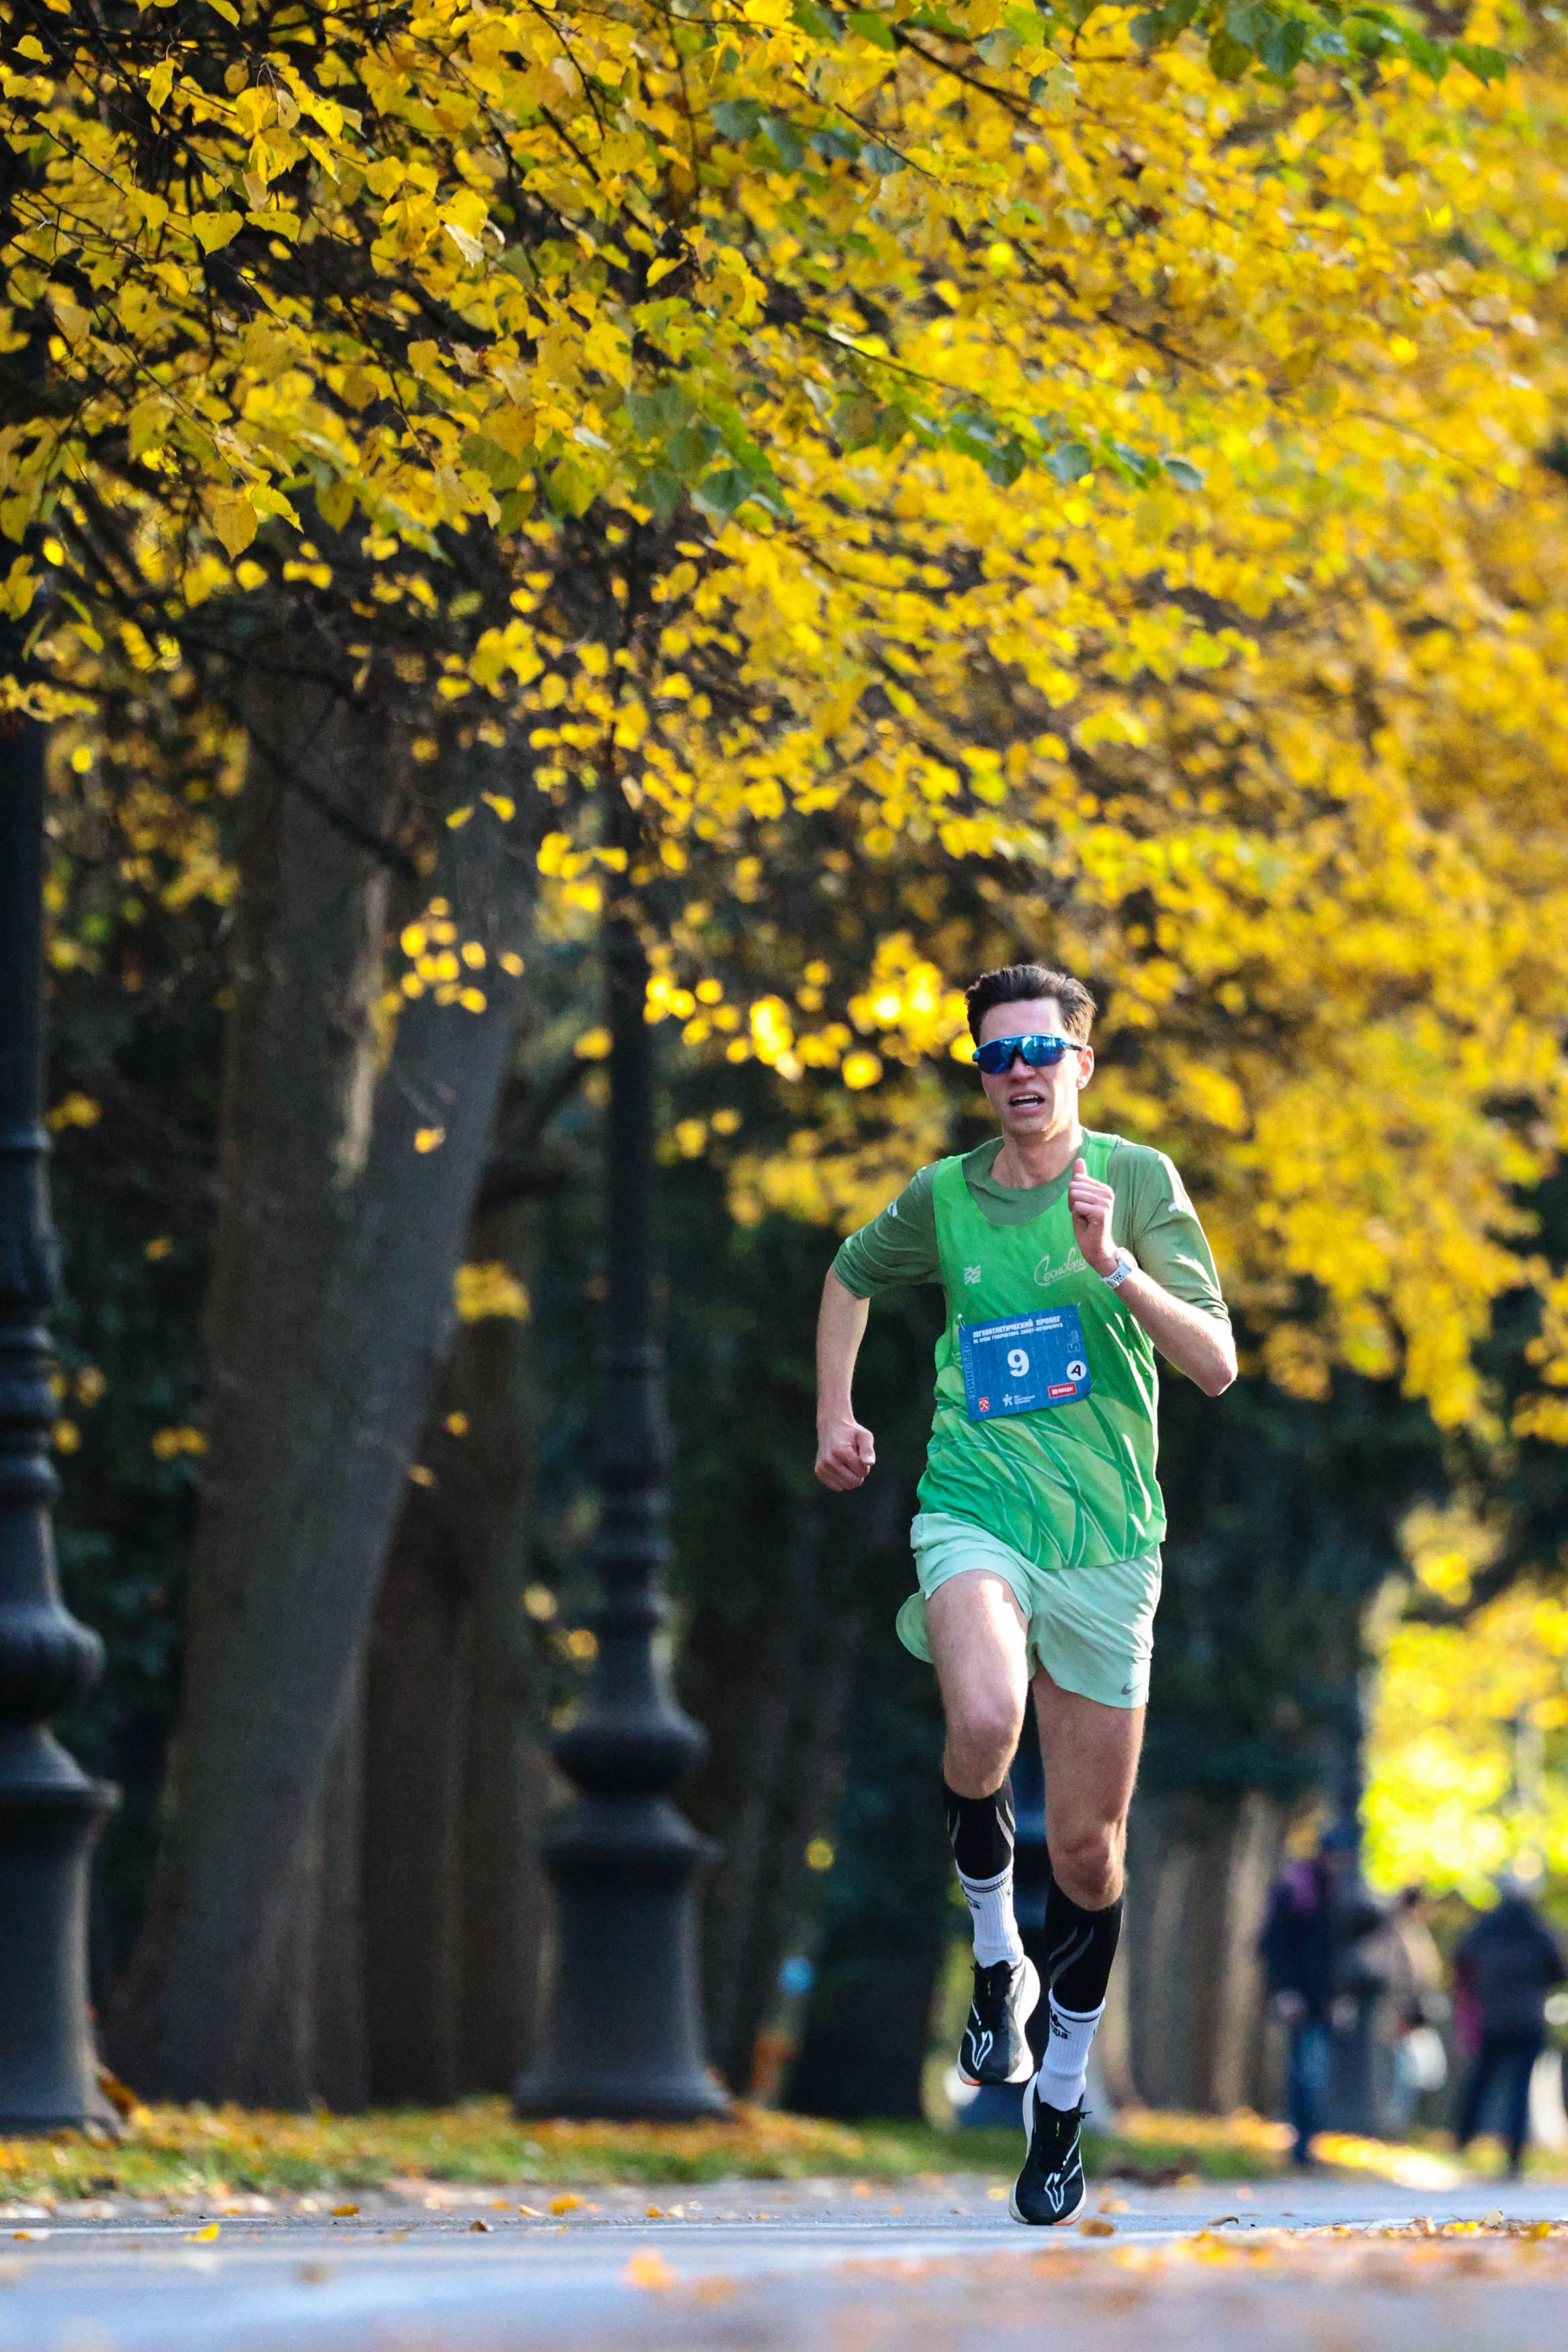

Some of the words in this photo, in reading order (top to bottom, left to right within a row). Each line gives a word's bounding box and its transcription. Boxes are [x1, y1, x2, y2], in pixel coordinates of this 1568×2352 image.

[973, 1319, 1033, 1338] ЛЕГКОАТЛЕТИЧЕСКИЙ
[1036, 1315, 1061, 1326] ПРОБЕГ
[961, 1342, 976, 1403] ЕДИНСТВО
[1007, 1349, 1030, 1377] 9
